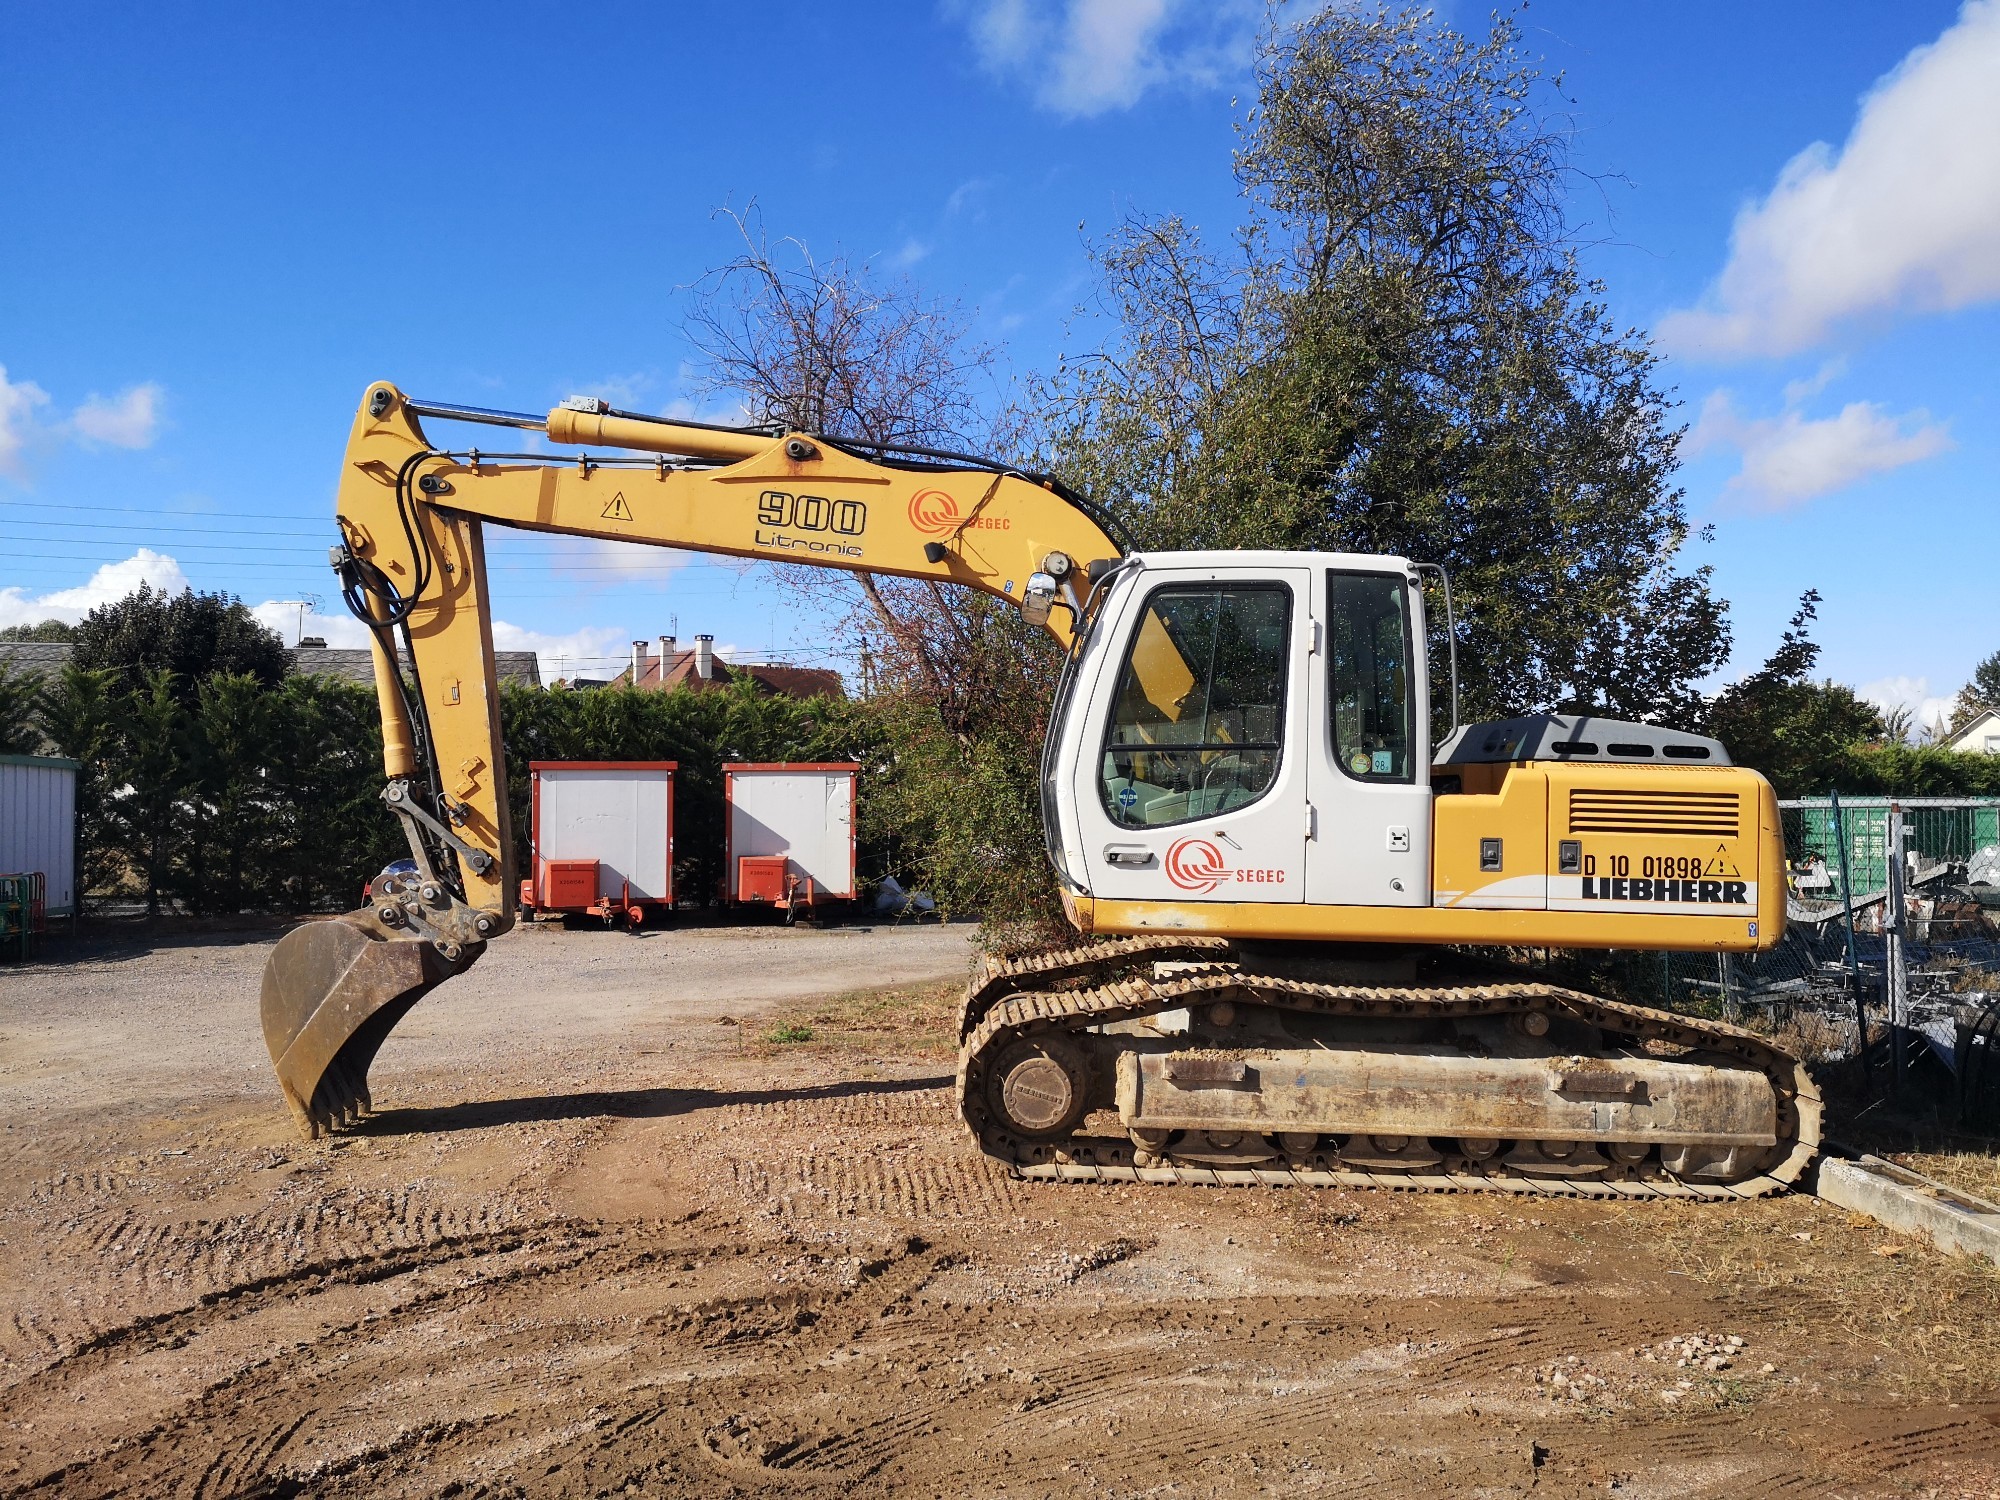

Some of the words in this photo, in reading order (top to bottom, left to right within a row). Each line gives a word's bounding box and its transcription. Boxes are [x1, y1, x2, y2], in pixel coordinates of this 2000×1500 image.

[758, 490, 867, 536] 900
[755, 529, 863, 557] Litronic
[1236, 869, 1285, 883] SEGEC
[1584, 854, 1596, 876] D
[1609, 855, 1630, 877] 10
[1643, 856, 1702, 879] 01898
[1582, 876, 1748, 904] LIEBHERR
